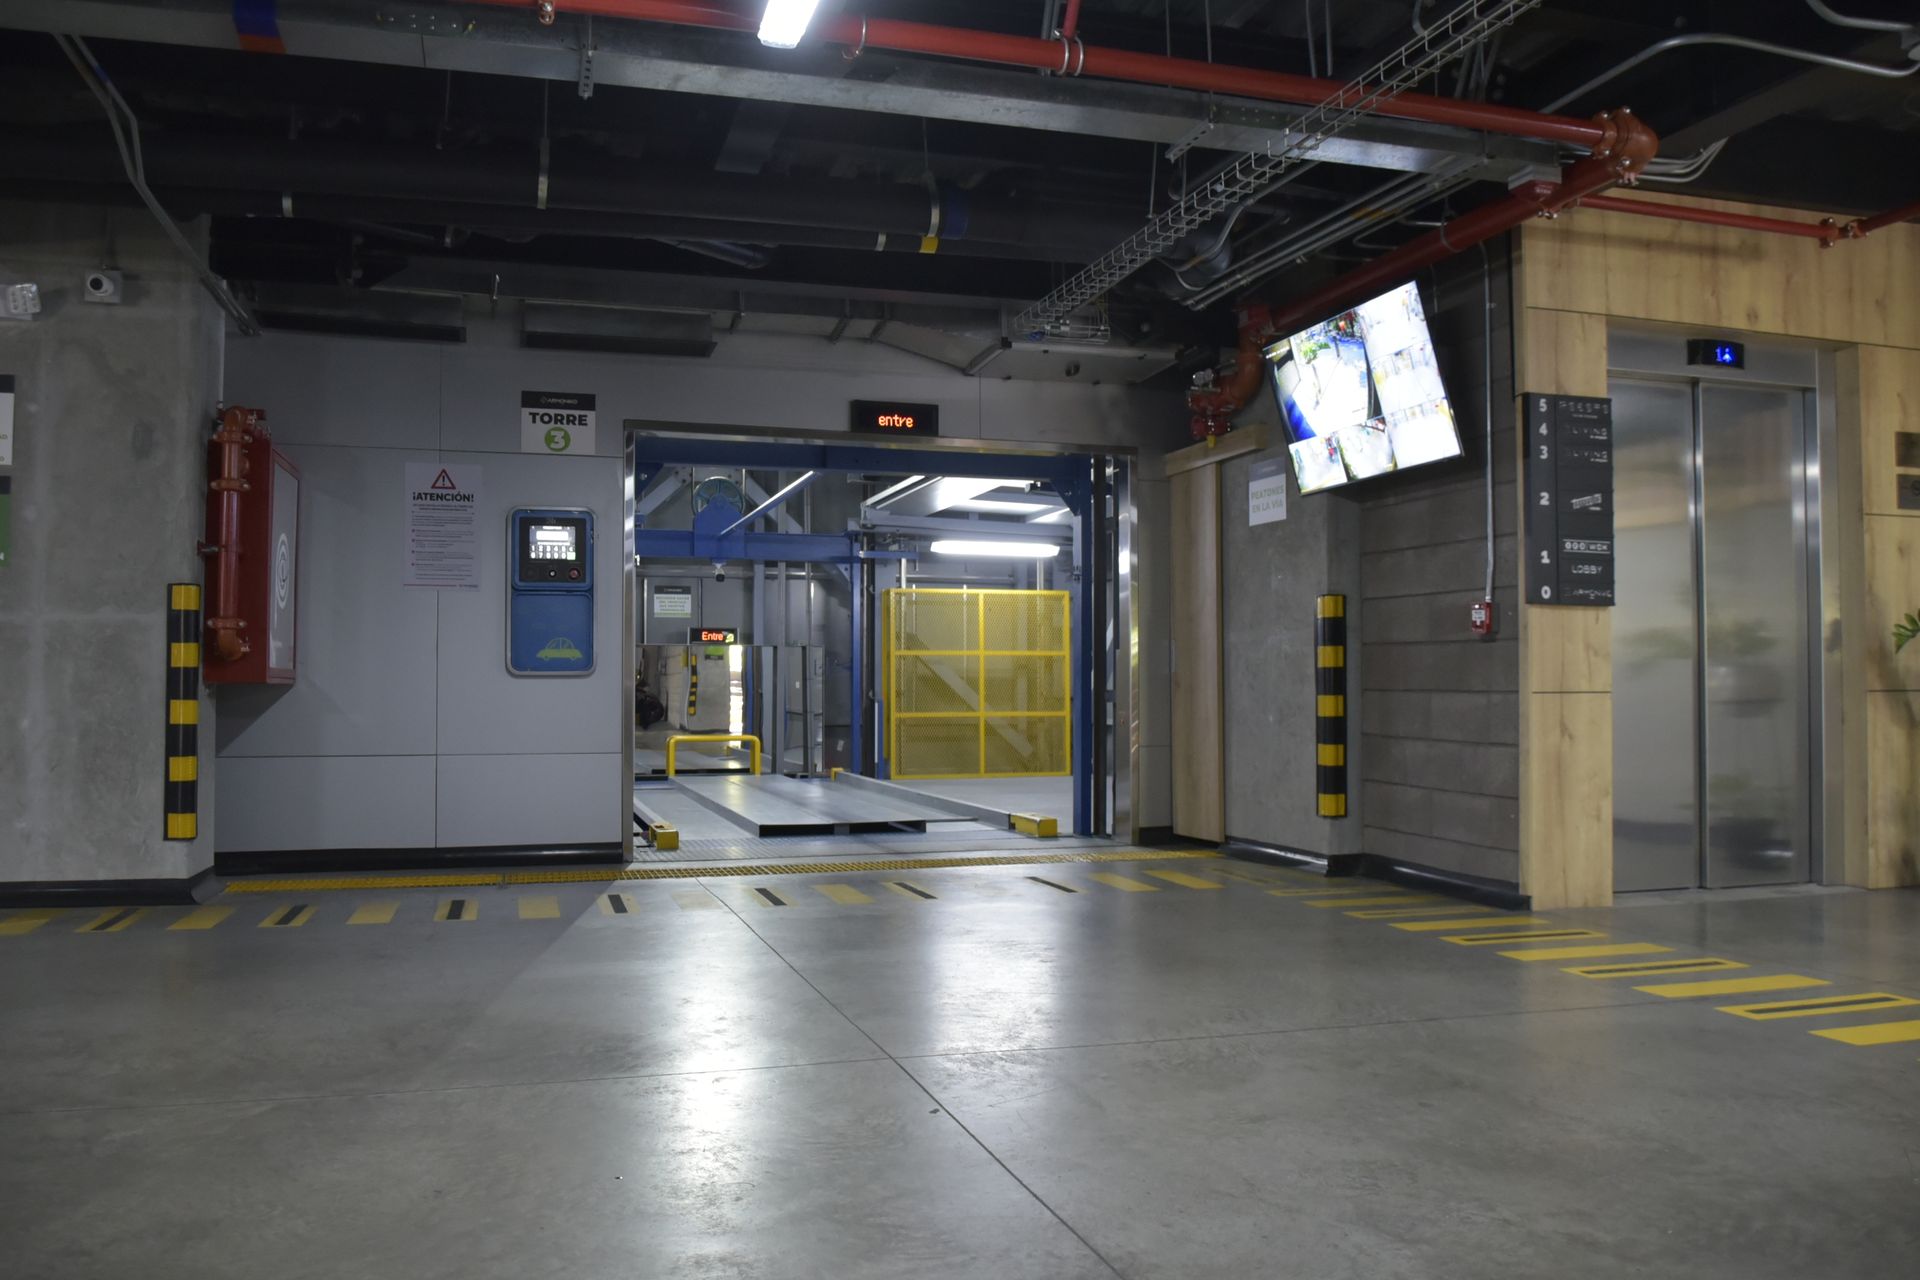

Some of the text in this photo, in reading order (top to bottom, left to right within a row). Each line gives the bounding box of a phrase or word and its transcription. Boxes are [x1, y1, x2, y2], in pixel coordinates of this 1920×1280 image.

[1715, 346, 1723, 362] 1
[1539, 398, 1548, 412] 5
[529, 412, 588, 426] TORRE
[878, 414, 913, 428] entre
[1538, 423, 1548, 436] 4
[550, 430, 565, 449] 3
[1539, 445, 1549, 460] 3
[412, 491, 474, 502] ¡ATENCIÓN!
[1539, 492, 1550, 506] 2
[1540, 550, 1551, 564] 1
[1571, 564, 1602, 574] LOBBY
[1540, 585, 1551, 599] 0
[701, 631, 723, 641] Entre
